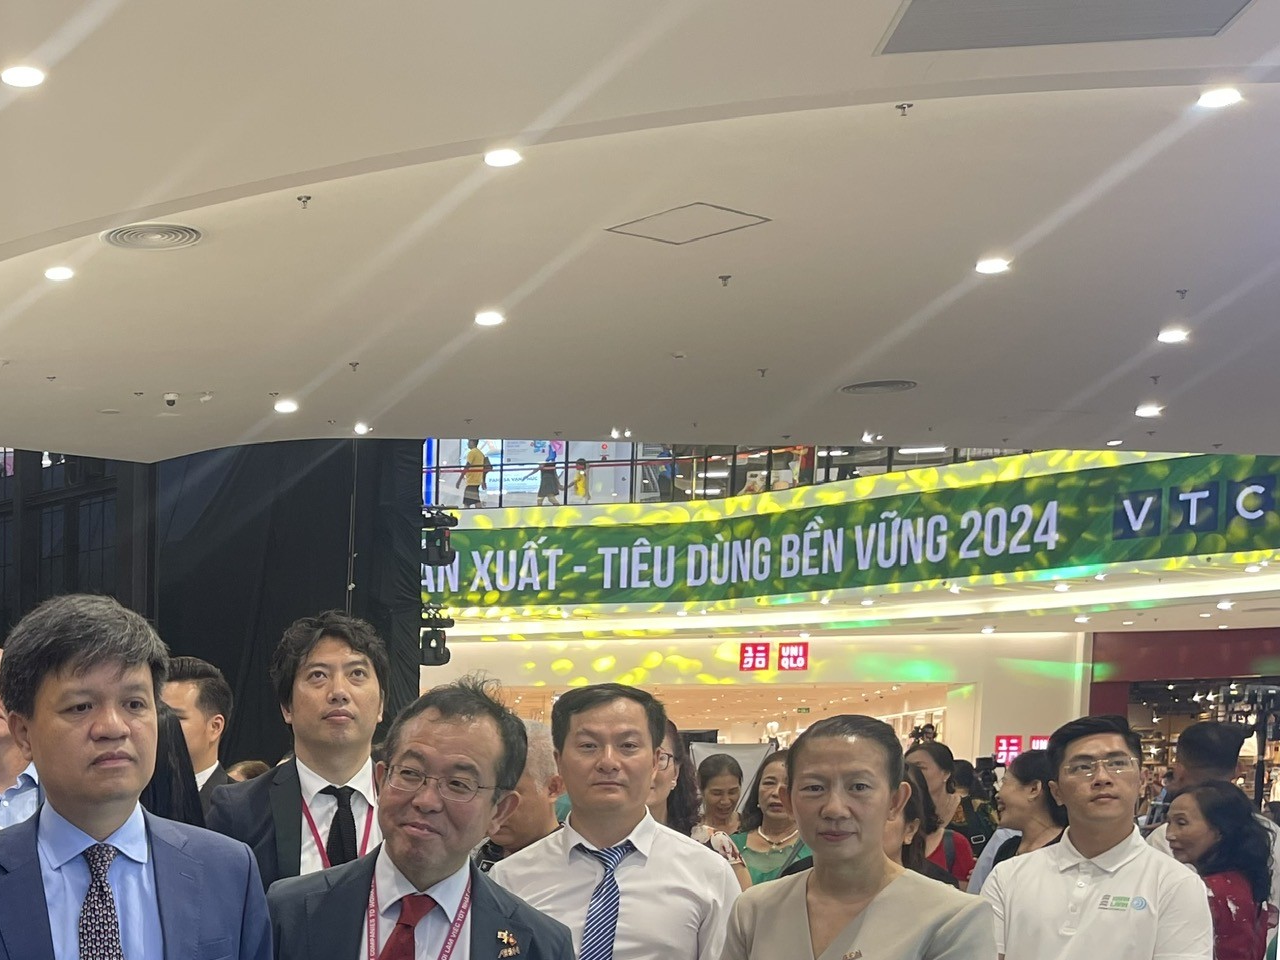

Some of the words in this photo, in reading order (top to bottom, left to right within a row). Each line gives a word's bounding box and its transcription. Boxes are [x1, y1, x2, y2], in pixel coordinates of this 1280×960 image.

[1123, 485, 1265, 531] VTC
[470, 536, 563, 592] XUẤT
[598, 538, 675, 590] TIÊU
[686, 533, 771, 587] DÙNG
[780, 516, 844, 579] BỀN
[855, 510, 948, 571] VỮNG
[959, 501, 1059, 560] 2024
[781, 646, 803, 657] UNI
[781, 657, 805, 669] QLO
[1031, 739, 1048, 750] UN
